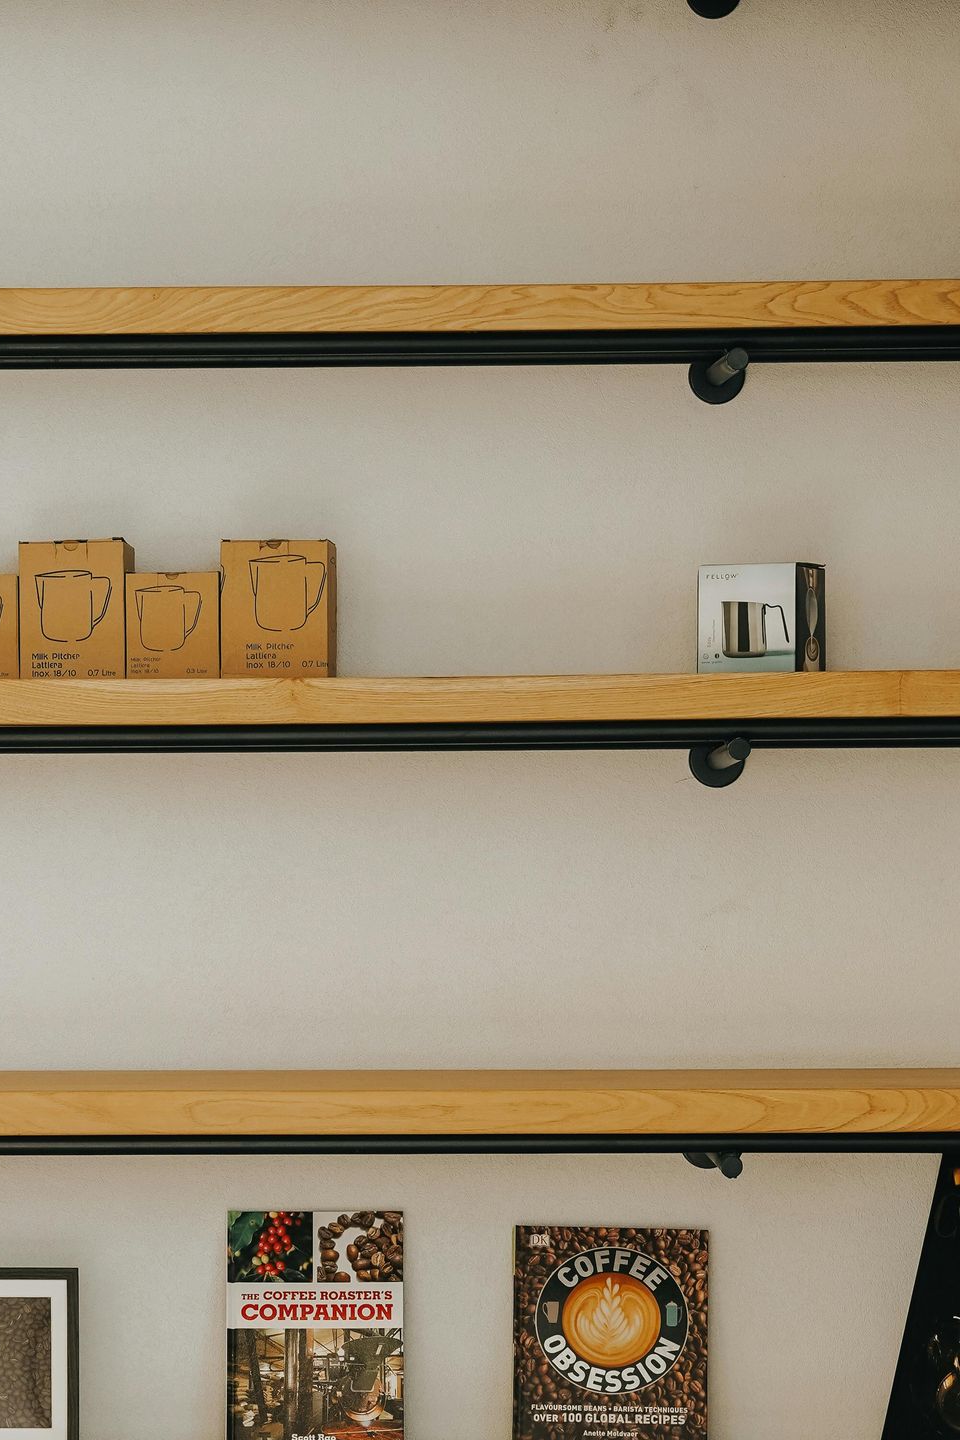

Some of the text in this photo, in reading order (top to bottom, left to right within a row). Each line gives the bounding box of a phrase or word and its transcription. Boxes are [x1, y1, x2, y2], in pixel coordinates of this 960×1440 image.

[266, 642, 295, 650] Pitcher
[268, 661, 291, 669] 18/10
[54, 669, 76, 678] 18/10
[532, 1235, 549, 1245] DK
[557, 1250, 669, 1291] COFFEE
[263, 1291, 317, 1301] COFFEE
[320, 1291, 393, 1301] ROASTER'S
[240, 1303, 393, 1321] COMPANION
[543, 1334, 681, 1393] OBSESSION
[531, 1404, 582, 1412] FLAVOURSOME
[533, 1413, 687, 1425] OVER 100 GLOBAL RECIPES
